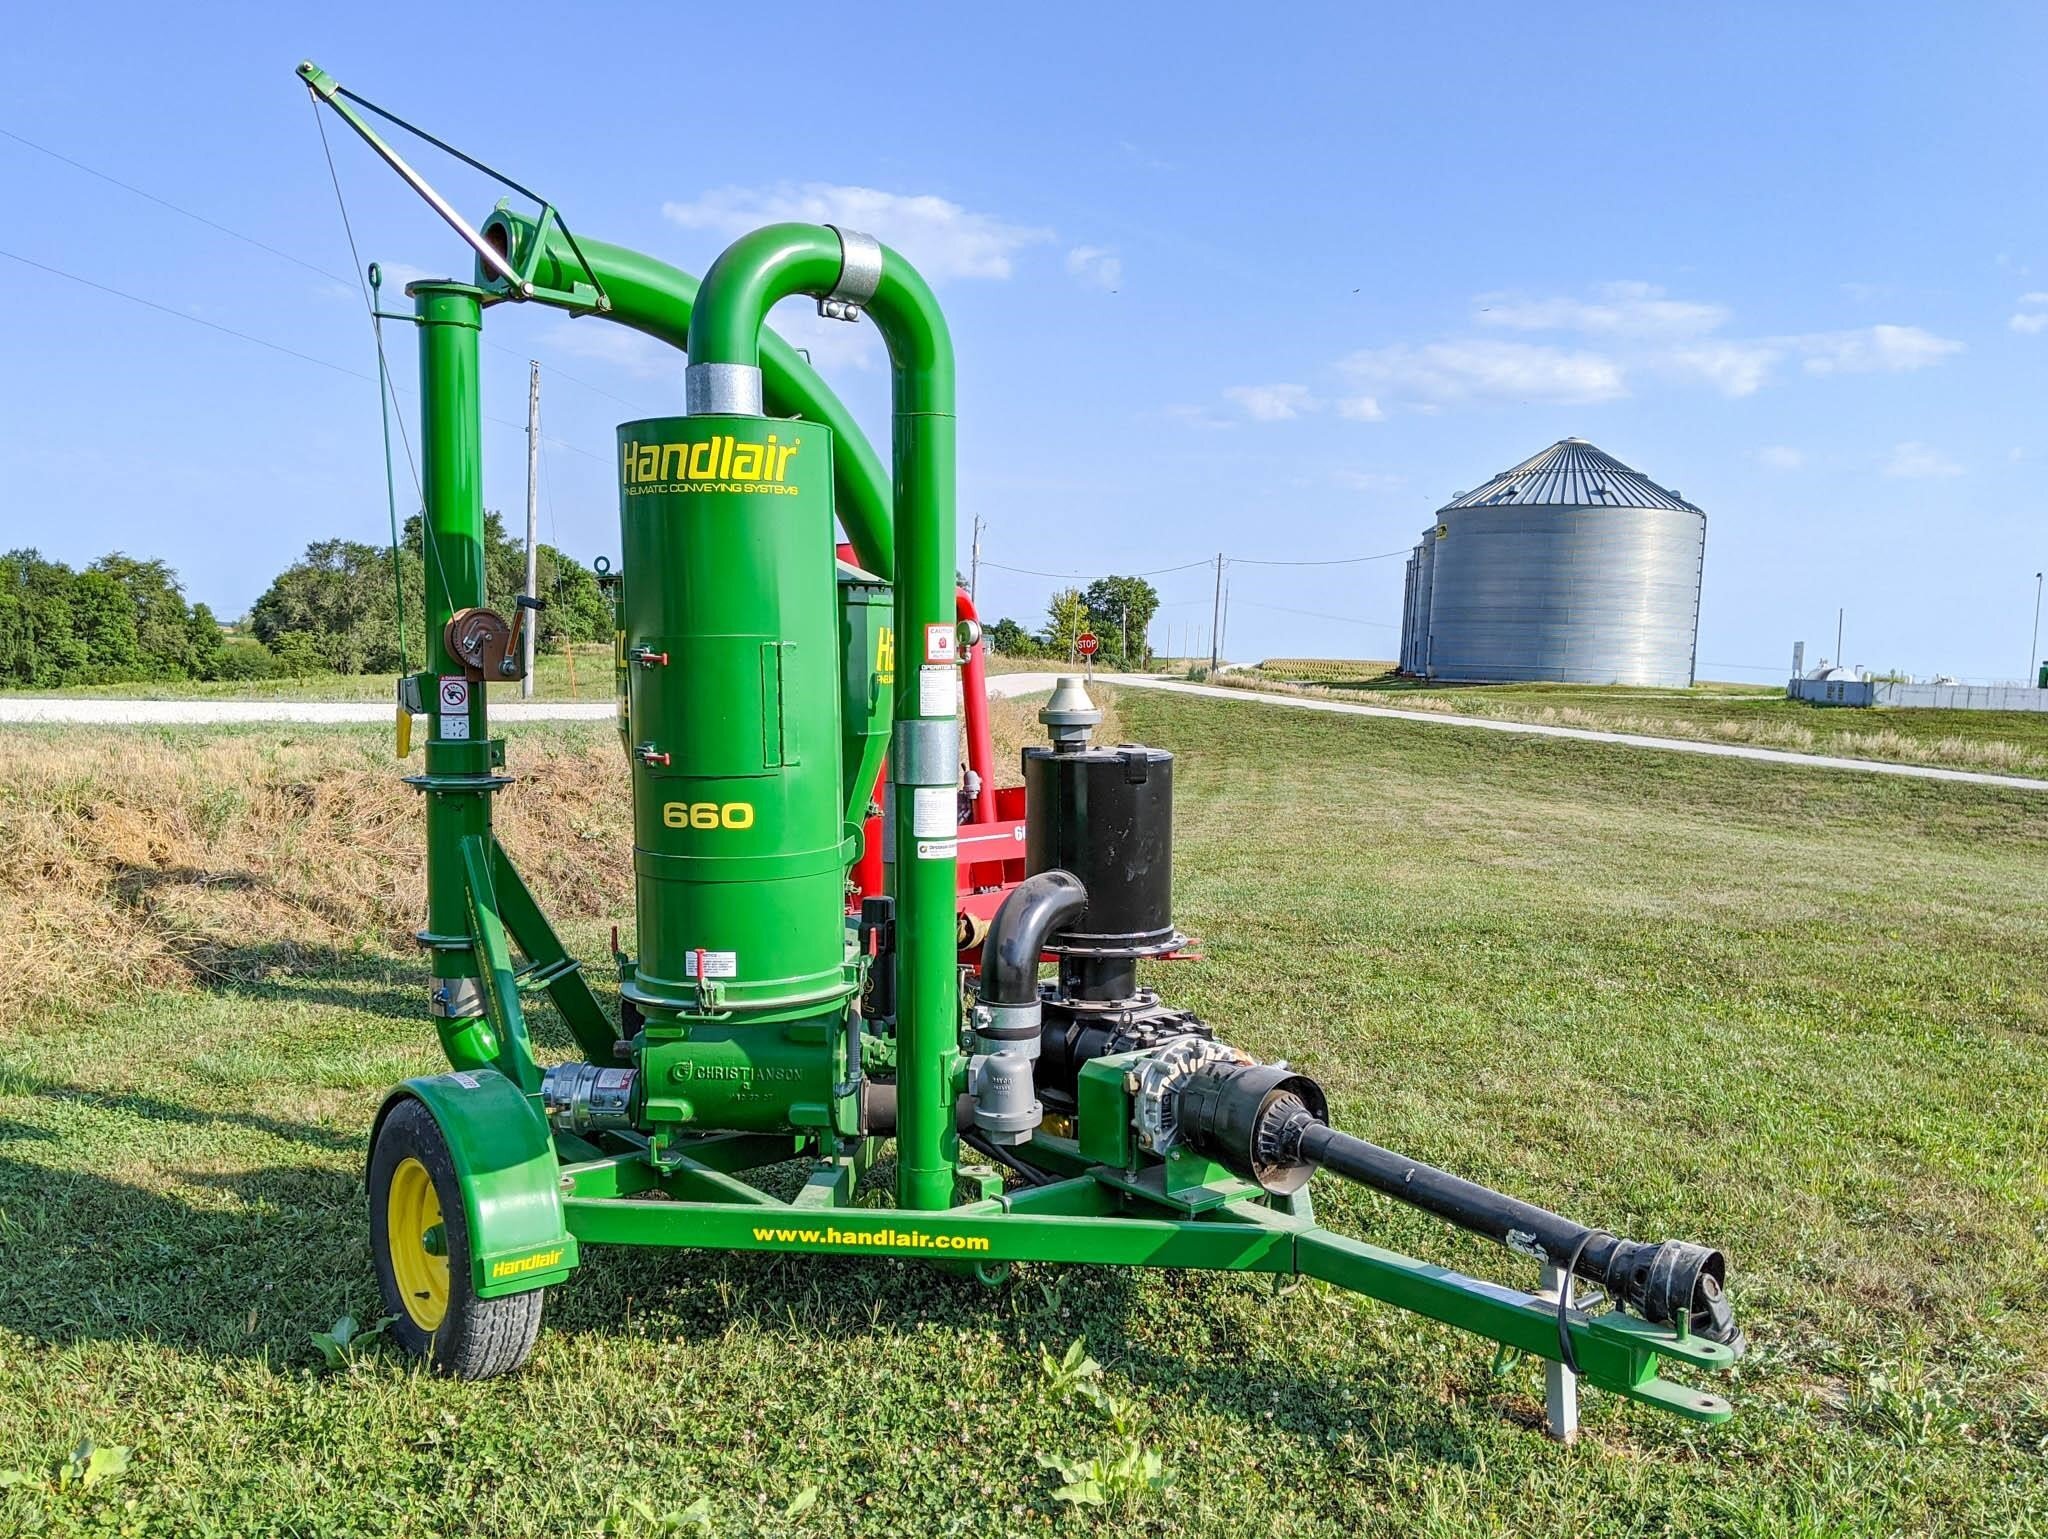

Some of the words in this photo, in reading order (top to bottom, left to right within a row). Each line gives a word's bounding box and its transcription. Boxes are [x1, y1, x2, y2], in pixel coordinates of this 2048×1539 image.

[624, 434, 798, 484] Handlair
[624, 484, 668, 496] PNEUMATIC
[669, 482, 742, 494] CONVEYING
[743, 483, 799, 496] SYSTEMS
[1078, 639, 1097, 649] STOP
[662, 801, 754, 829] 660
[697, 1066, 803, 1081] CHRISTIANSON
[752, 1227, 990, 1251] www.handlair.com
[492, 1249, 564, 1279] Handlair
